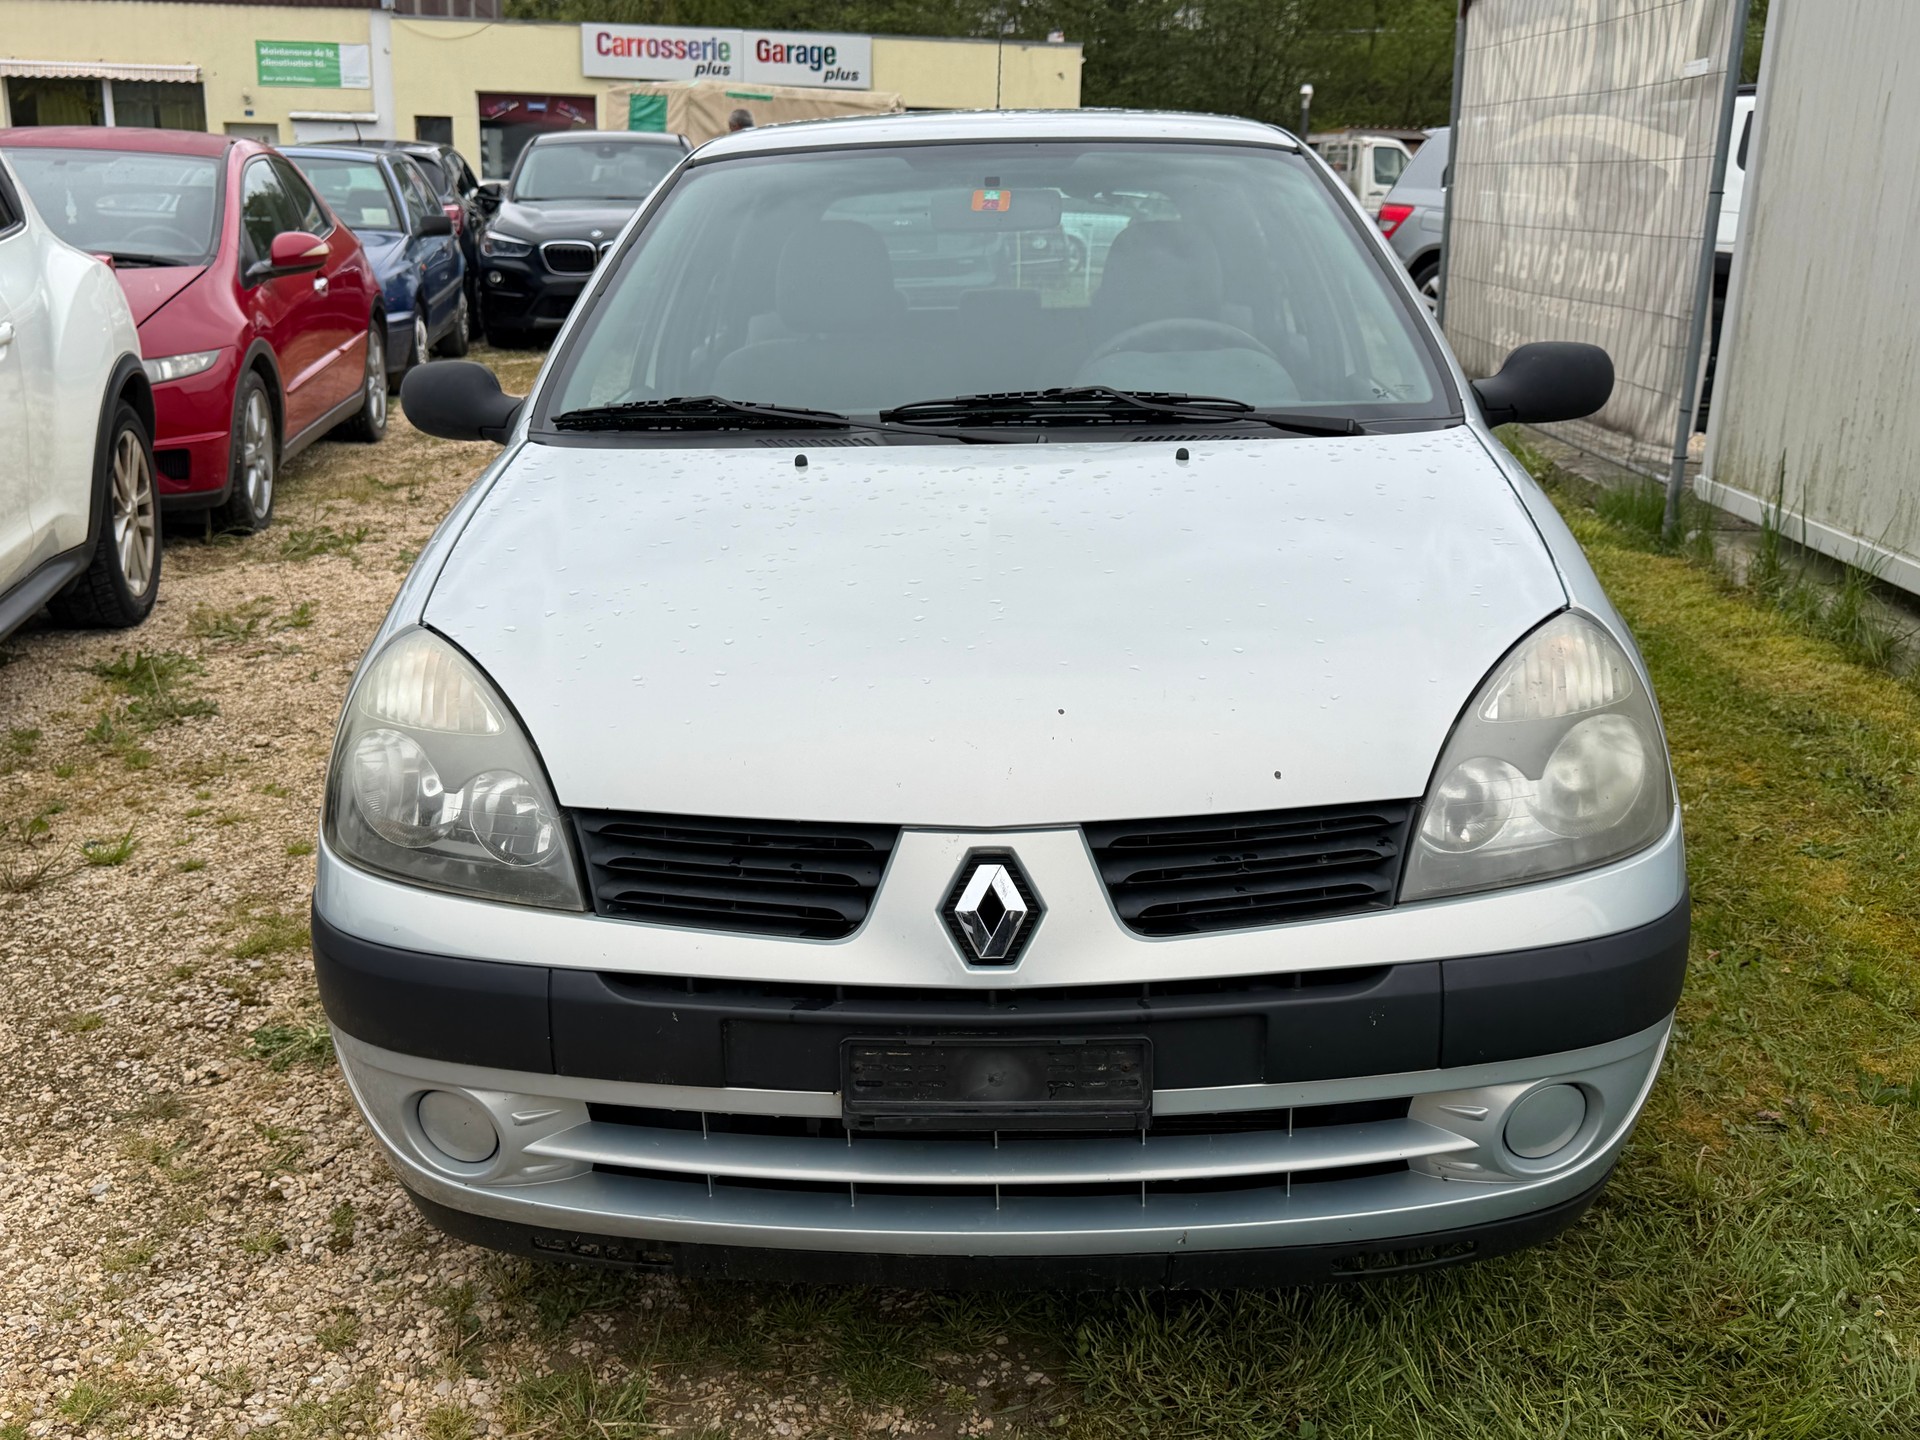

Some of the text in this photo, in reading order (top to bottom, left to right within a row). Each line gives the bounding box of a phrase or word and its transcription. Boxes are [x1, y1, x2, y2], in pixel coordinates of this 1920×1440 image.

[596, 31, 731, 62] Carrosserie
[756, 38, 837, 72] Garage
[694, 62, 731, 78] plus
[823, 67, 860, 83] plus
